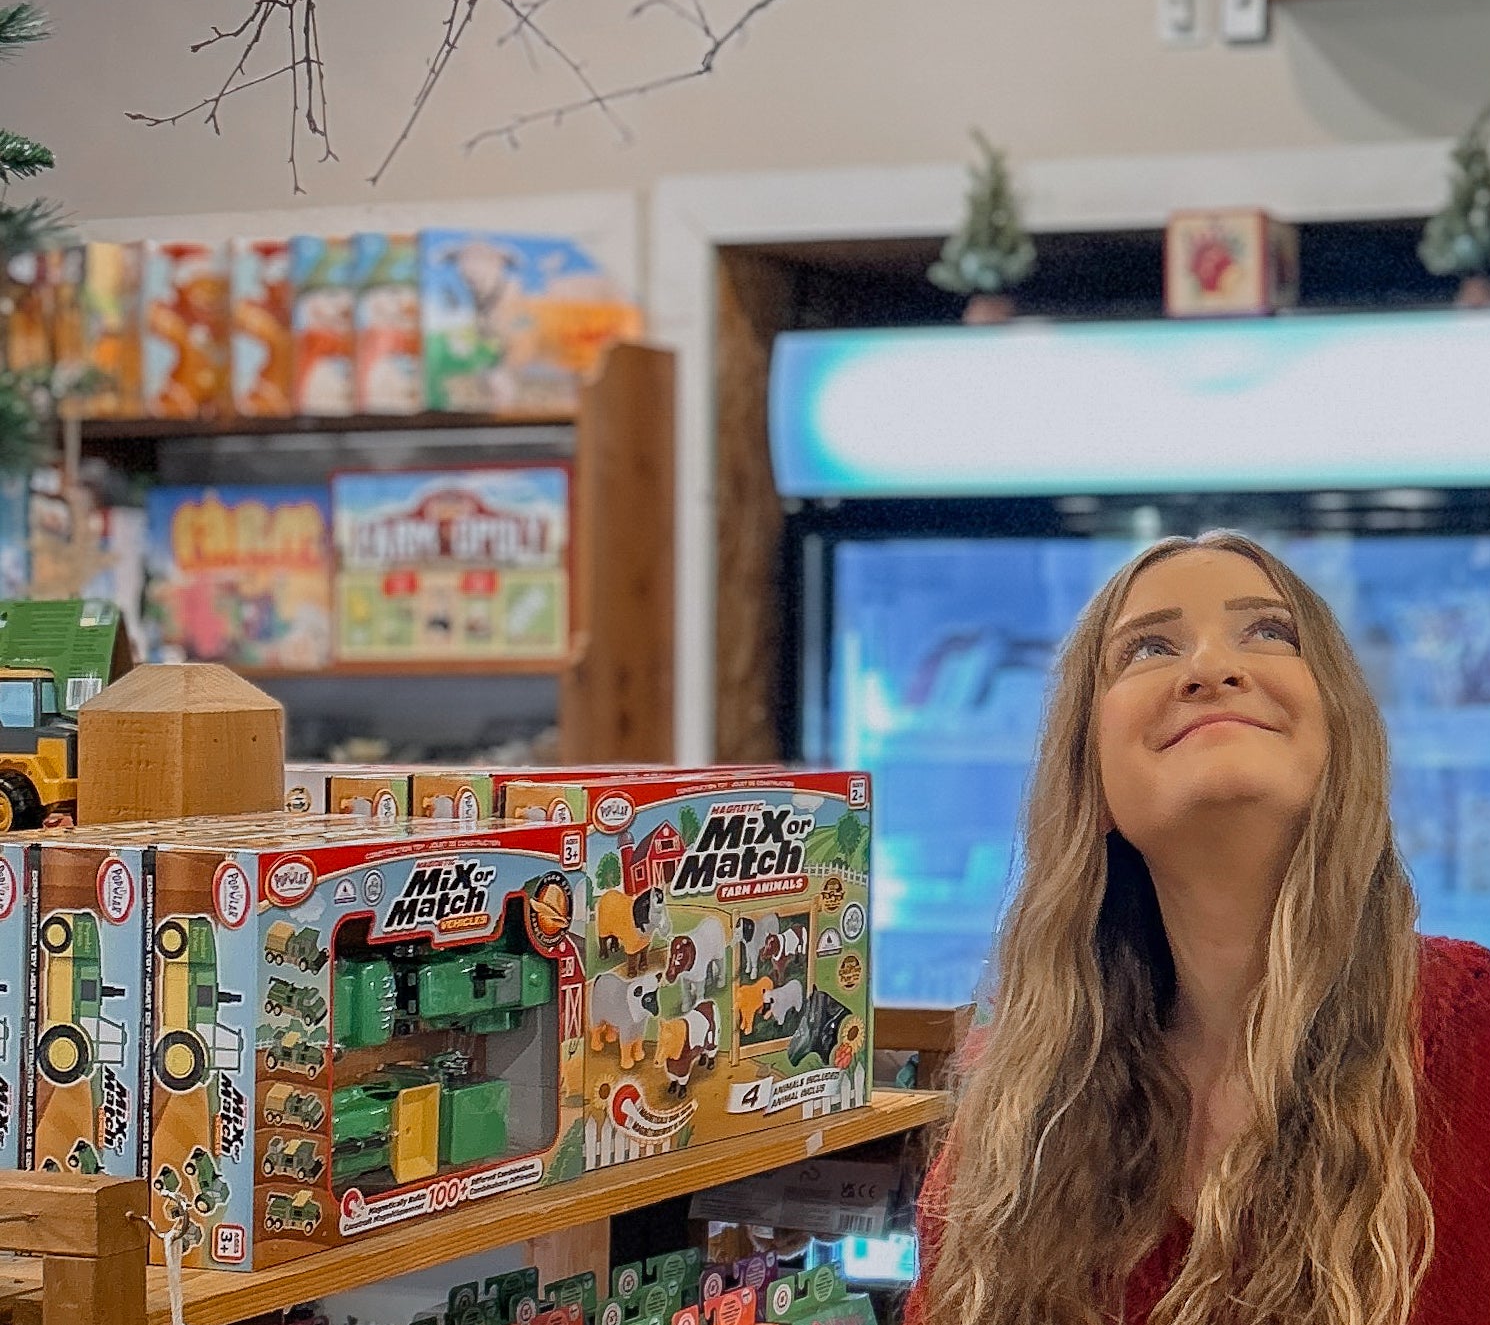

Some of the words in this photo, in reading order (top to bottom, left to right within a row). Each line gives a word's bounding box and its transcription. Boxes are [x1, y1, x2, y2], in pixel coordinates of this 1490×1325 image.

[711, 802, 764, 816] MAGNETIC
[851, 789, 864, 802] 2+
[696, 810, 790, 853] MiX
[787, 817, 812, 836] or
[565, 846, 578, 861] 3+
[674, 841, 802, 890] Match
[404, 863, 478, 898] MiX
[473, 867, 494, 883] or
[721, 883, 752, 899] FARM
[754, 877, 804, 895] ANIMALS
[384, 887, 485, 928] Match
[104, 1065, 116, 1147] Match
[741, 1084, 761, 1109] 4
[220, 1072, 233, 1154] Match
[428, 1179, 469, 1209] 100+
[219, 1231, 232, 1254] 3+
